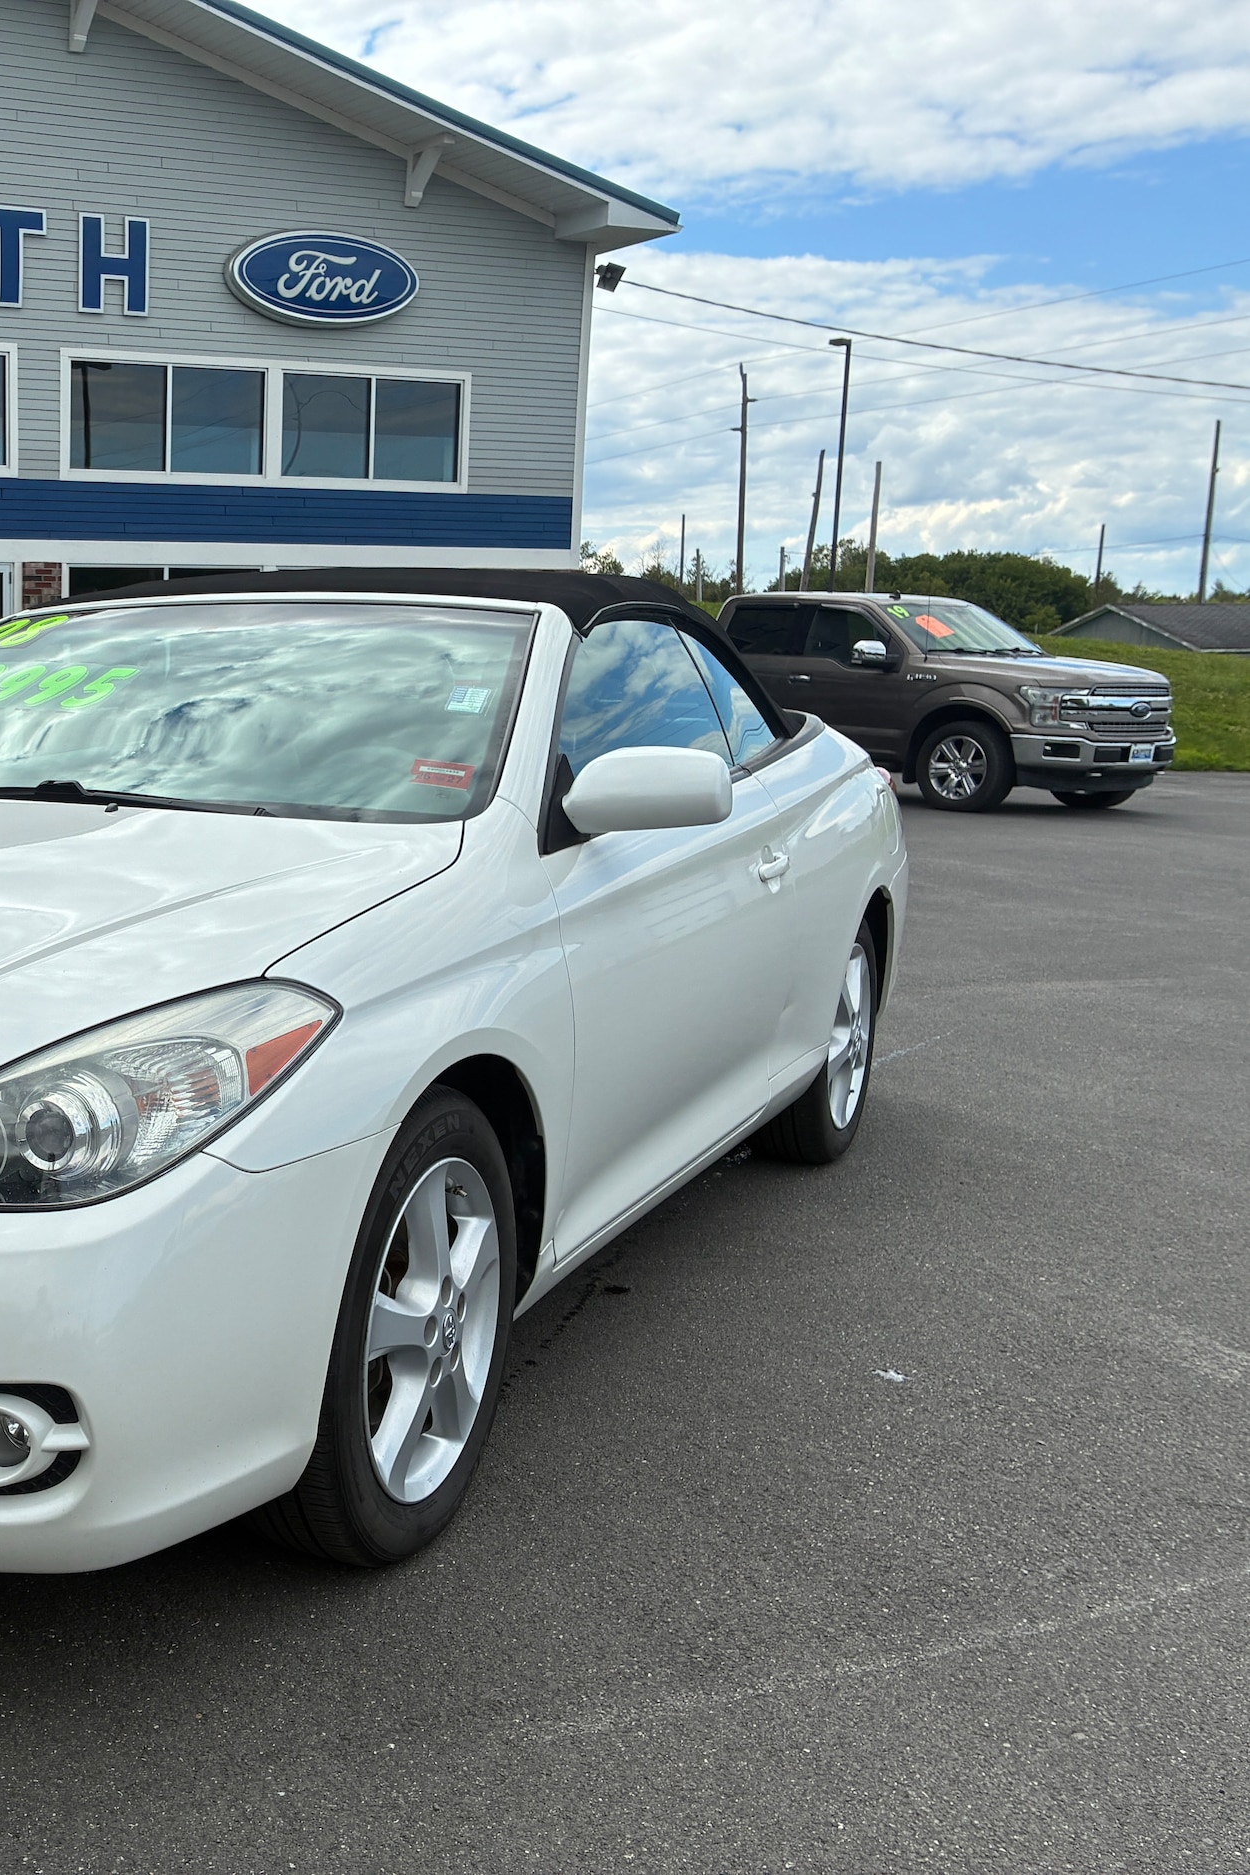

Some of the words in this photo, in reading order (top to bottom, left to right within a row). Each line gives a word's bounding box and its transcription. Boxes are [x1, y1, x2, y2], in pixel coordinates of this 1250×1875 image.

[276, 250, 382, 305] Ford
[886, 605, 911, 620] 19
[389, 1112, 461, 1201] NEXEN
